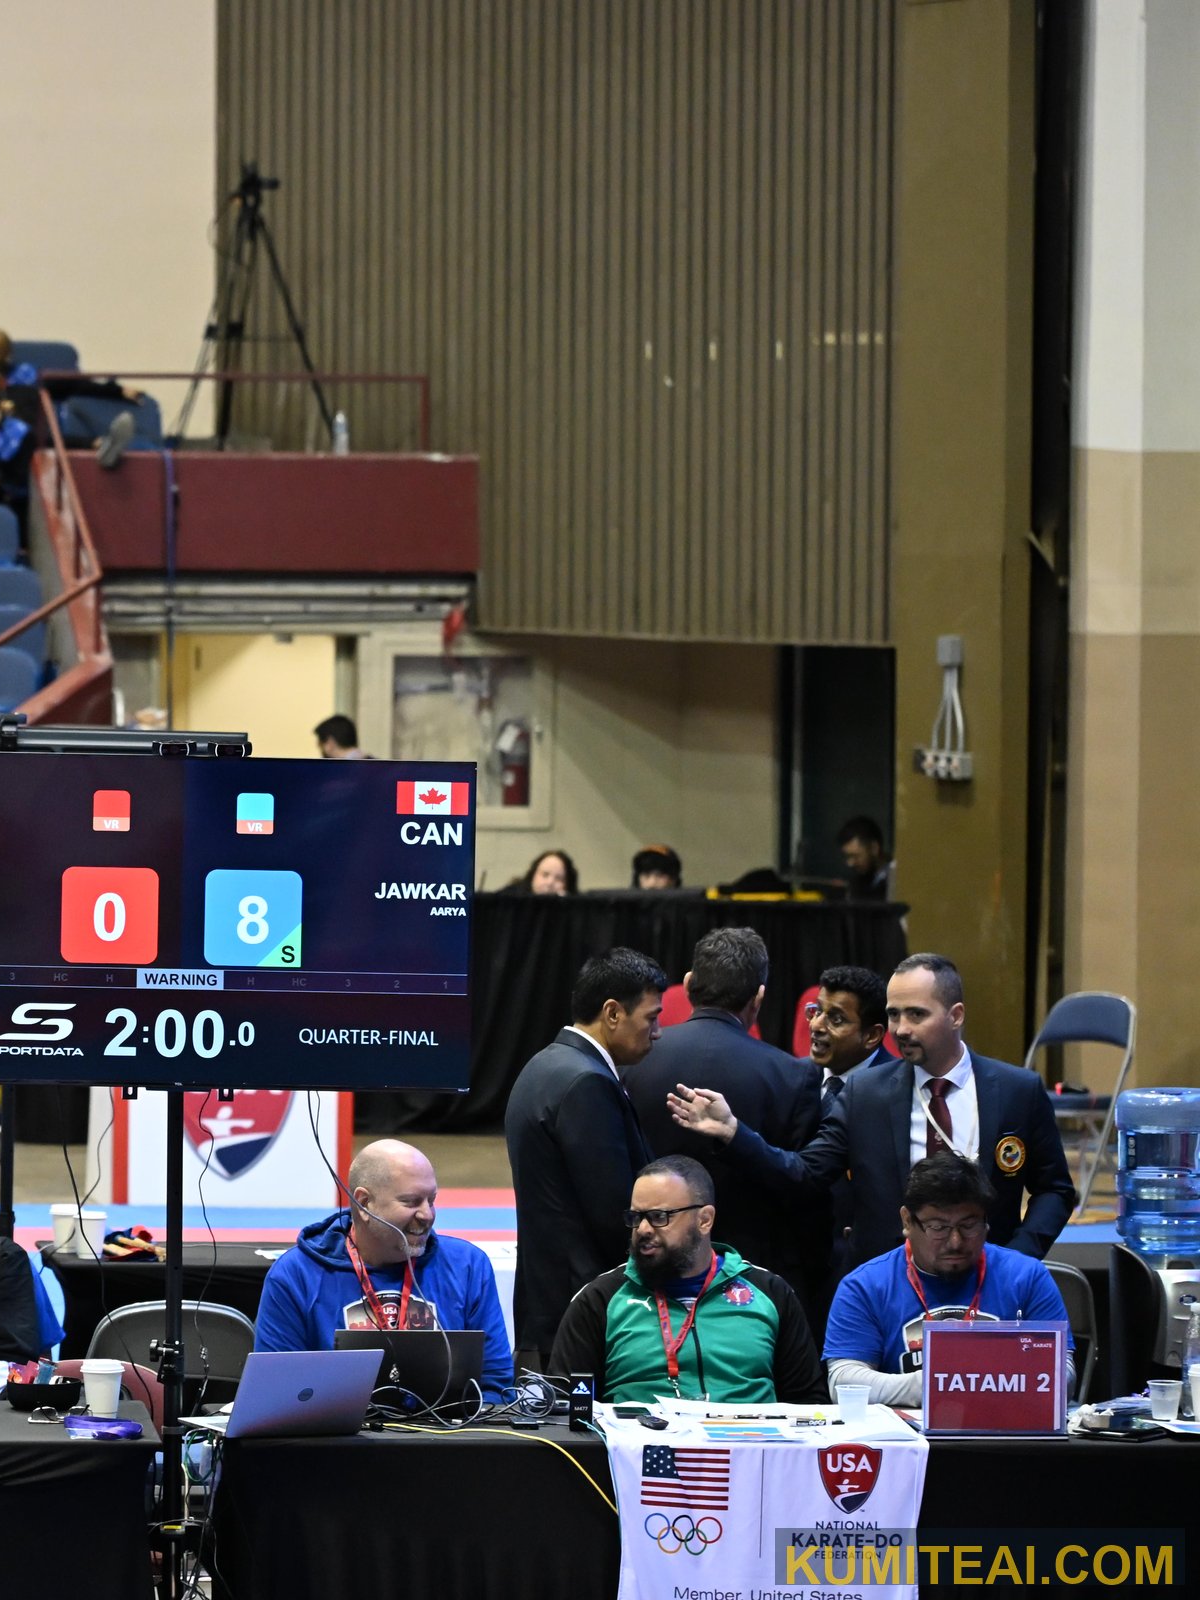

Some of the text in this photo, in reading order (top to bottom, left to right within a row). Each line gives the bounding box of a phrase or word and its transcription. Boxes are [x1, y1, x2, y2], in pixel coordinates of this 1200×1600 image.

[103, 819, 120, 829] VR
[247, 822, 263, 832] VR
[400, 821, 463, 846] CAN
[374, 882, 467, 900] JAWKAR
[93, 892, 126, 942] 0
[430, 906, 467, 916] AARYA
[236, 895, 270, 945] 8
[281, 945, 296, 964] S
[10, 972, 16, 981] 3
[54, 973, 69, 982] HC
[106, 974, 114, 983] H
[145, 973, 218, 986] WARNING
[247, 976, 255, 986] H
[292, 977, 307, 987] HC
[299, 1028, 439, 1046] QUARTER-FINAL
[383, 1306, 398, 1315] USA
[934, 1373, 1050, 1392] TATAMI 2
[826, 1452, 873, 1473] USA
[815, 1520, 881, 1531] NATIONAL
[791, 1532, 903, 1548] KARATE-DO
[674, 1586, 862, 1600] Member United States
